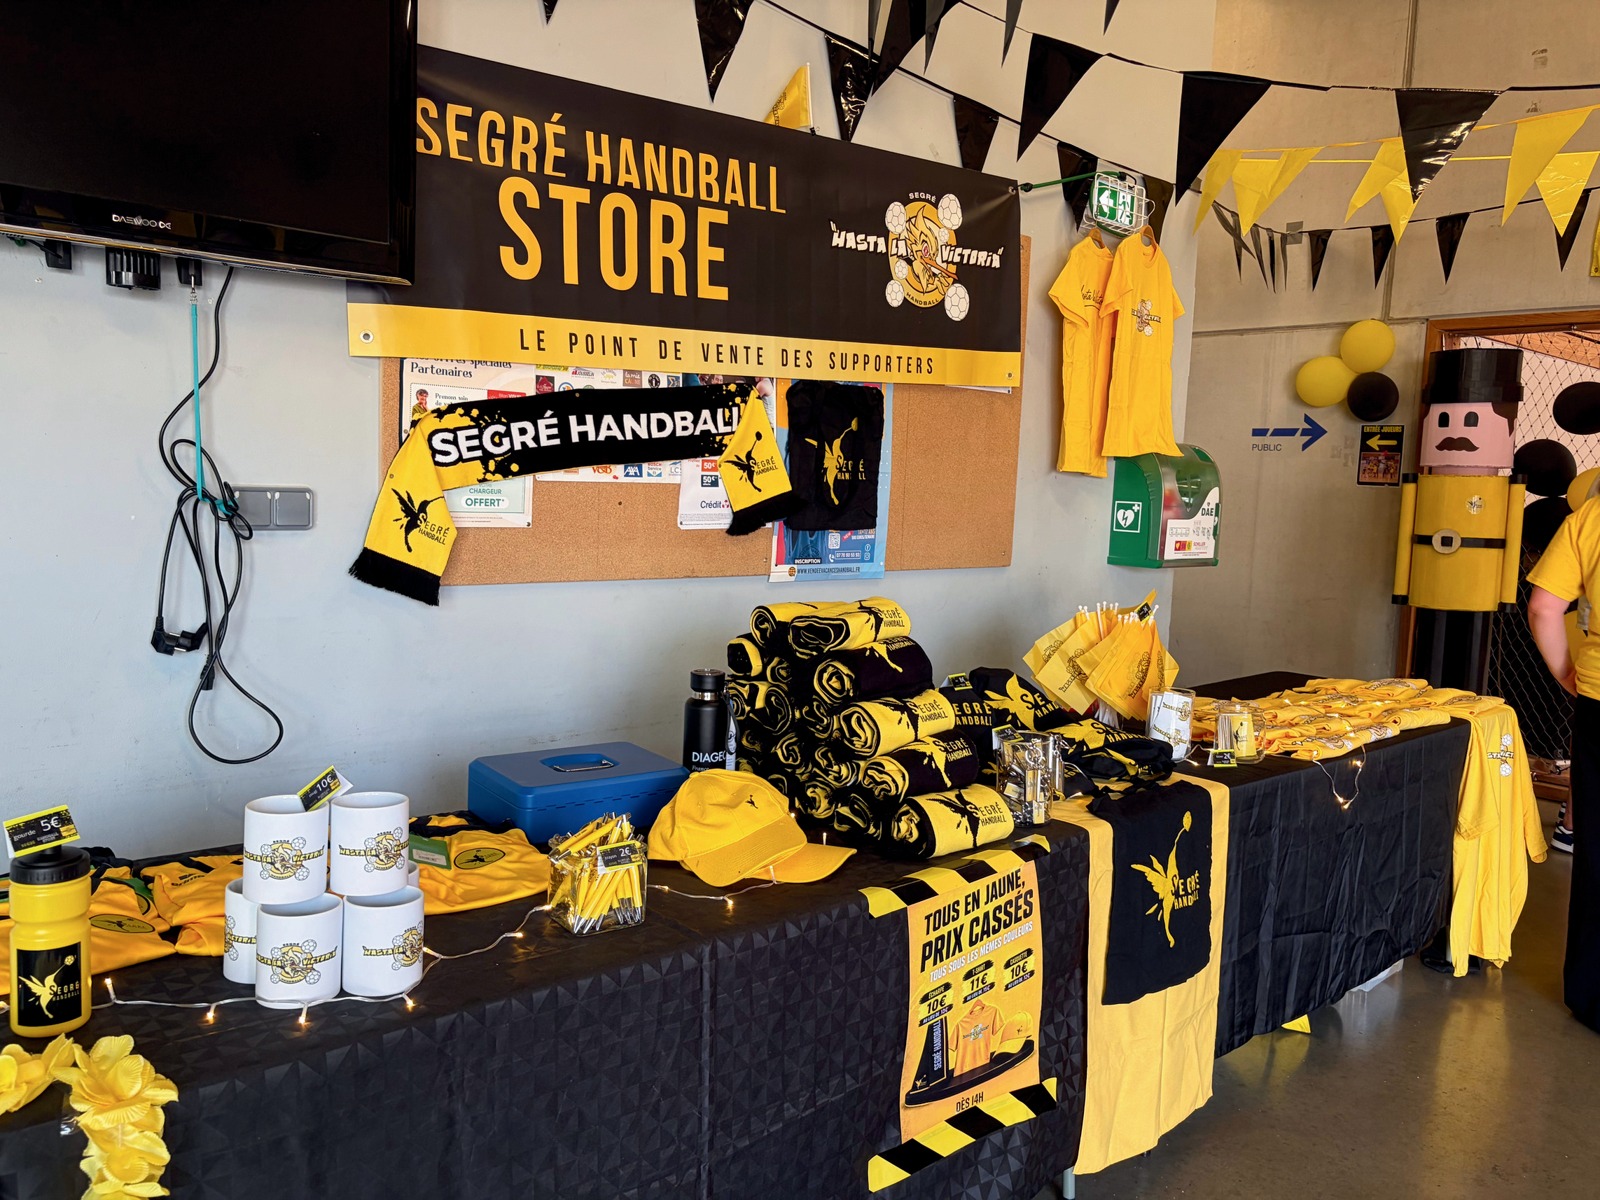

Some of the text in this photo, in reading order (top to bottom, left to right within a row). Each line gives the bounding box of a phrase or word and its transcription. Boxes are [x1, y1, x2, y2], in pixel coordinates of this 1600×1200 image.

[415, 97, 787, 214] SEGRÉ HANDBALL
[908, 191, 937, 203] SEGRÉ
[111, 214, 158, 228] DAEWOO
[498, 176, 730, 301] STORE
[890, 238, 909, 258] LA
[906, 291, 941, 307] HANDBALL
[519, 328, 934, 375] LE POINT DE VENTE DES SUPPORTERS
[410, 361, 473, 378] Partenaires
[430, 406, 740, 464] SEGRÉ HANDBALL
[1363, 425, 1403, 433] ENTRÉE JOUEURS
[1251, 443, 1282, 452] PUBLIC
[624, 465, 641, 477] AXA
[748, 456, 776, 471] SEGRÉ
[755, 464, 779, 476] HANDBALL
[836, 472, 867, 481] HANLL
[468, 487, 502, 495] CHARGEUR
[700, 500, 722, 514] Crédit
[1200, 507, 1214, 517] DAE
[417, 512, 450, 538] SEGRÉ
[418, 527, 446, 546] HANDBALL
[883, 620, 905, 628] HANDBALL
[906, 699, 943, 715] SEGRÉ
[1034, 701, 1060, 718] HAND
[920, 711, 949, 723] HANDBALL
[954, 715, 993, 727] ANDBALL
[932, 738, 970, 754] SEGRÉ
[946, 747, 974, 762] HANDBALL
[316, 774, 334, 792] 10€
[965, 801, 1004, 818] SEGRÉ
[980, 814, 1008, 827] HANDBALL
[13, 829, 37, 842] gourde
[40, 816, 62, 832] 5€
[619, 847, 632, 857] 2€
[924, 868, 1025, 937] TOUS EN JAUNE,
[920, 888, 1034, 974] PRIX CASSÉS
[930, 921, 1033, 983] TOUS SOUS LES MÊMES COULEURS
[971, 963, 986, 976] T-SHIRT
[970, 972, 988, 992] 11€
[928, 985, 945, 999] ÉCHARPE
[933, 1019, 942, 1052] HANDBALL
[956, 1092, 984, 1113] DÈS 14H
